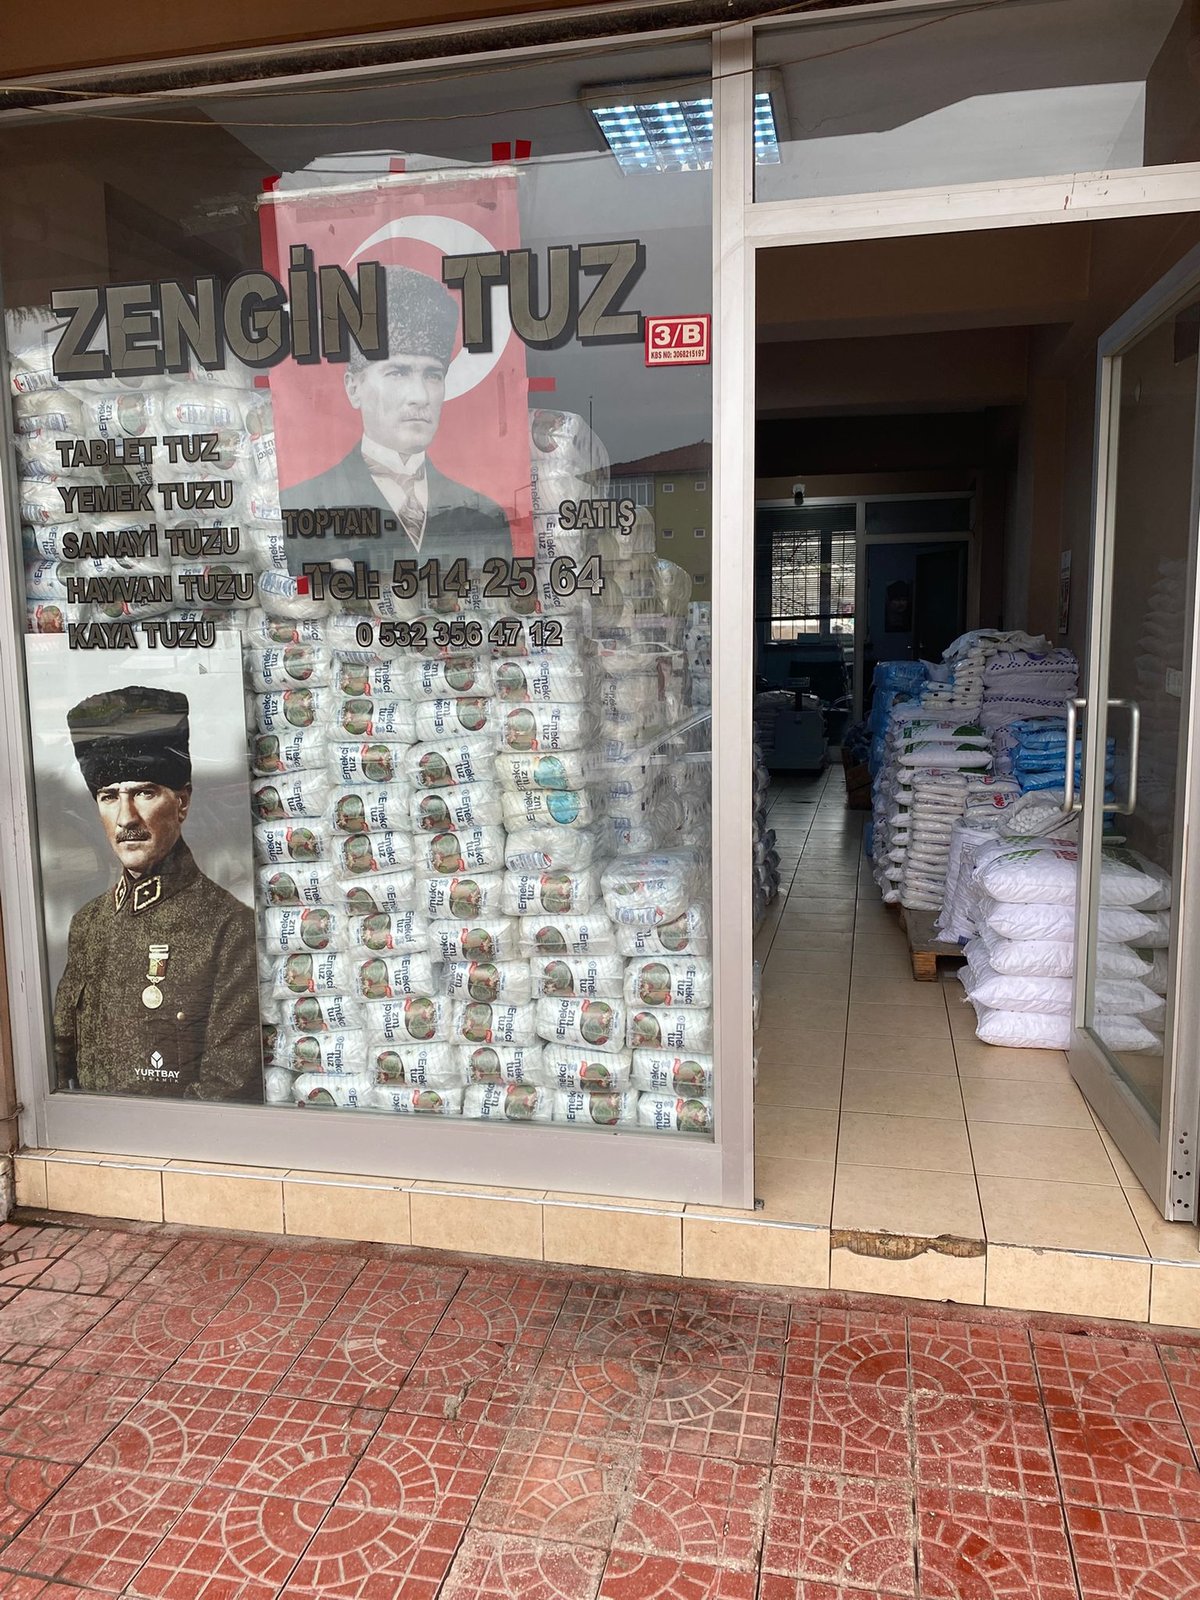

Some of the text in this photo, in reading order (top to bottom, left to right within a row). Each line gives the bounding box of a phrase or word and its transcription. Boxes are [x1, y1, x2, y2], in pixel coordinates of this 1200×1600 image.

[50, 239, 646, 381] ZENGİN TUZ
[654, 323, 701, 347] 3/B
[651, 351, 662, 359] KBS
[55, 434, 220, 467] TABLET TUZ
[57, 483, 155, 513] YEMEK
[158, 480, 233, 510] TUZU
[281, 508, 381, 538] TOPTAN
[559, 499, 637, 536] SATIŞ
[62, 524, 240, 559] SANAYİ TUZU
[66, 575, 174, 603] HAYVAN
[179, 573, 254, 600] TUZU
[302, 560, 380, 601] Tel:
[392, 558, 471, 599] 514
[482, 557, 538, 598] 25
[550, 555, 605, 597] 64
[69, 621, 216, 649] KAYA TUZU
[355, 620, 563, 648] 0 532 356 47 12
[134, 1068, 180, 1079] YURTBAY
